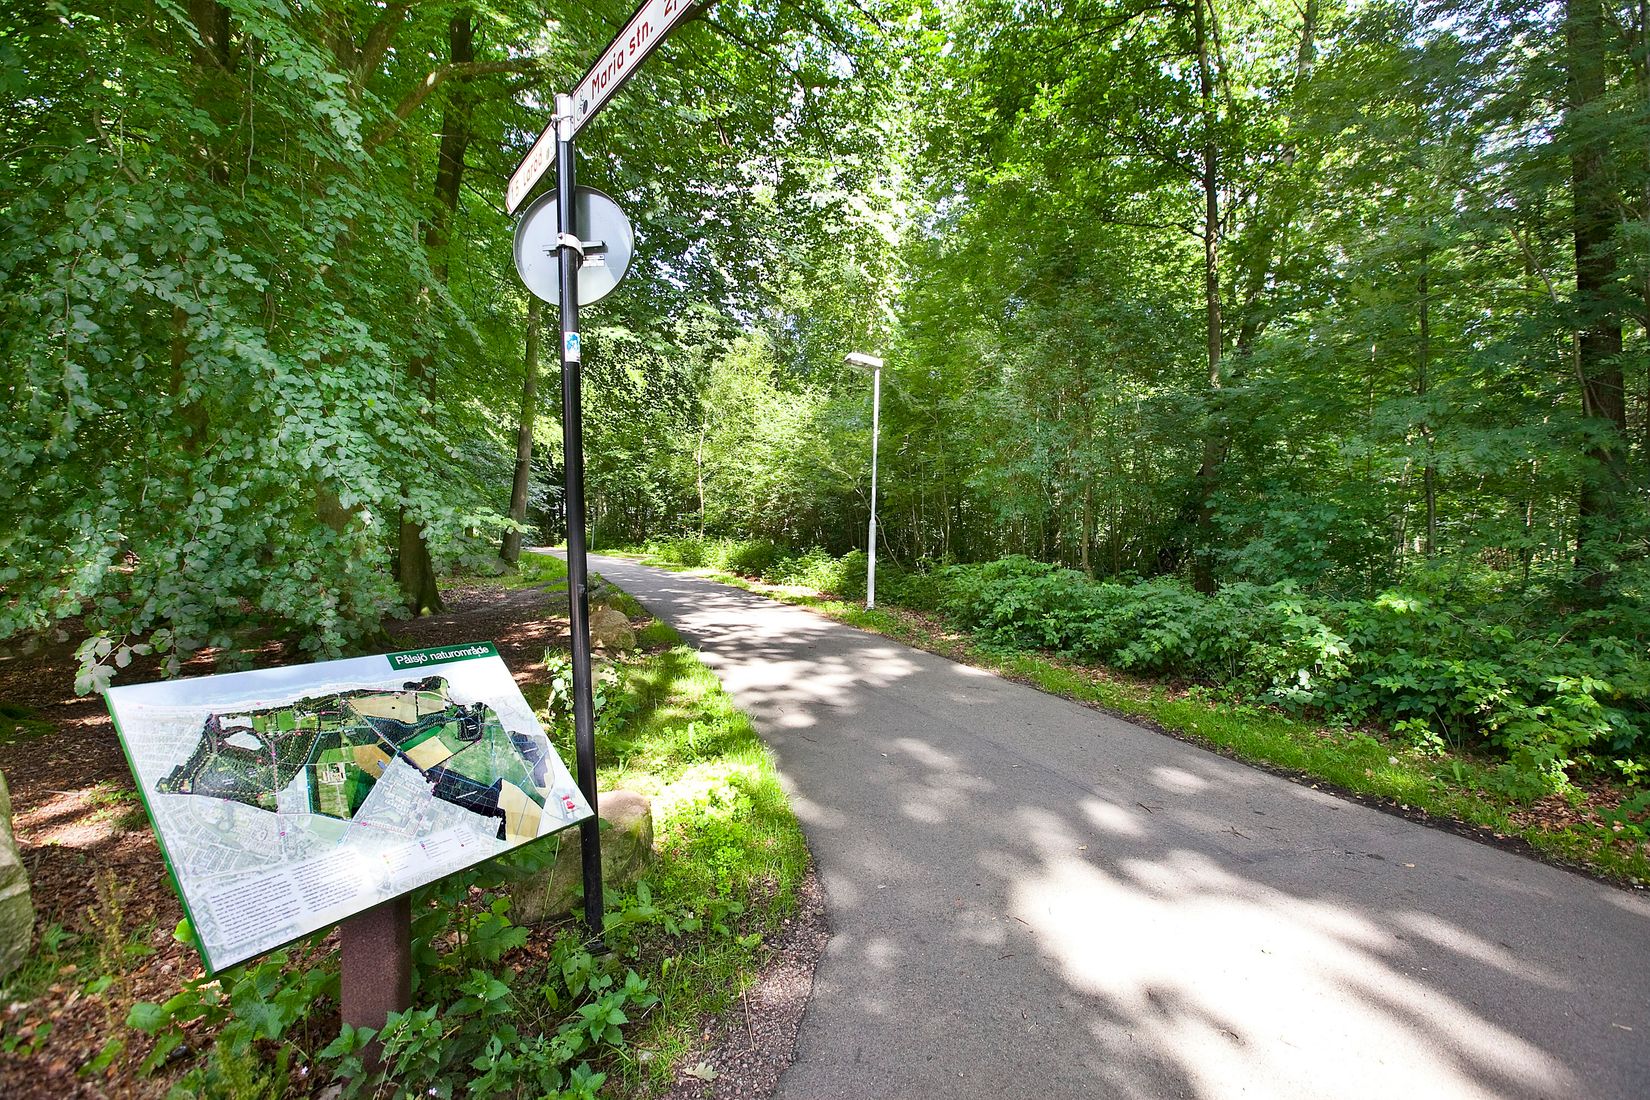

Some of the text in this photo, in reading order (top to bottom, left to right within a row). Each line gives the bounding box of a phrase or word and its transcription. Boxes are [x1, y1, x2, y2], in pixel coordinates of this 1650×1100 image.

[592, 50, 624, 100] Maria
[629, 21, 653, 56] stn.
[395, 645, 489, 665] Pålsjö naturområde
